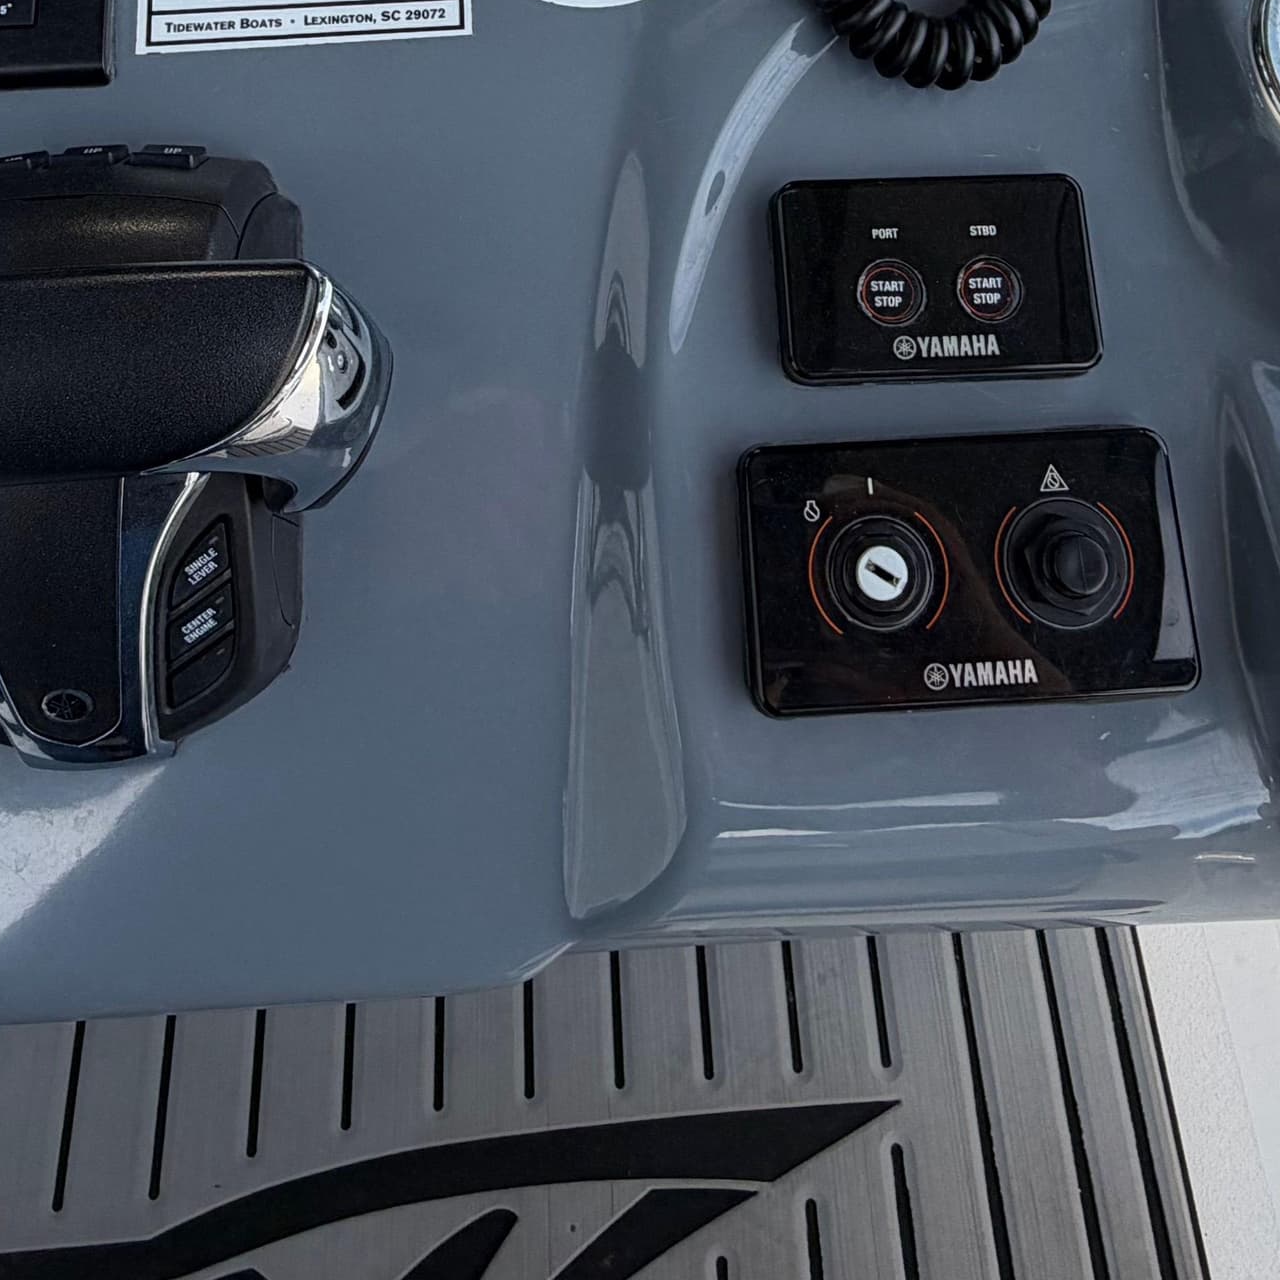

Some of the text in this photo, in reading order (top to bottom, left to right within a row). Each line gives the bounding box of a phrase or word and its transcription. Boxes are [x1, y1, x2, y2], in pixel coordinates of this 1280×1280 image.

[165, 8, 446, 33] TIDEWATER BOATS LEXINGTON, SC 29072
[871, 227, 899, 240] PORT
[969, 225, 997, 237] STBD
[870, 280, 905, 293] START
[968, 277, 1003, 290] START
[874, 295, 903, 308] STOP
[973, 292, 1001, 305] STOP
[917, 334, 1001, 358] YAMAHA
[184, 547, 219, 576] SINGLE
[187, 560, 219, 586] LEVER
[181, 607, 217, 634] CENTER
[183, 617, 218, 644] ENGINE
[948, 658, 1039, 688] YAMAHA
